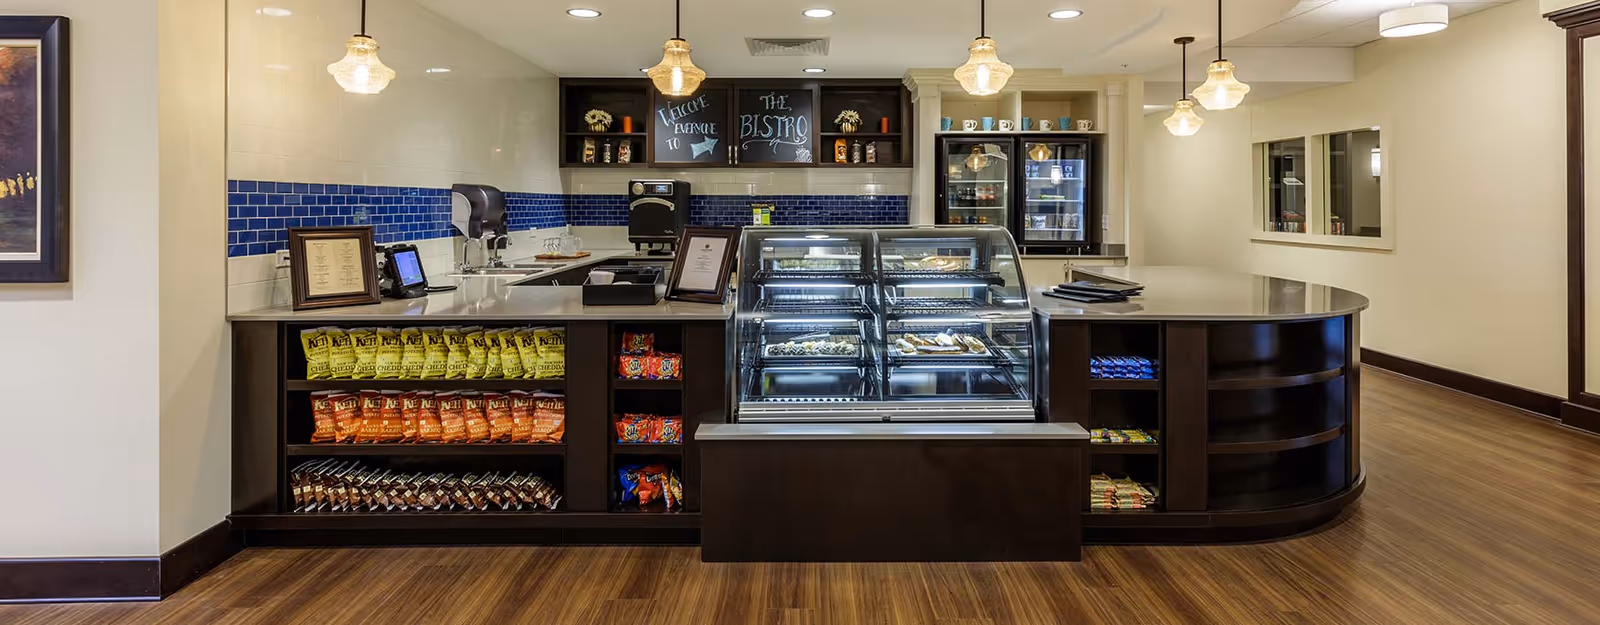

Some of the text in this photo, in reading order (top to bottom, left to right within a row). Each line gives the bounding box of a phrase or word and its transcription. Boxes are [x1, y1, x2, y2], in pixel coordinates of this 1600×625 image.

[657, 94, 710, 127] WELCOME
[759, 92, 792, 111] THE
[674, 121, 718, 135] EVERYONE
[740, 113, 808, 142] BISTRO
[664, 137, 681, 151] TO
